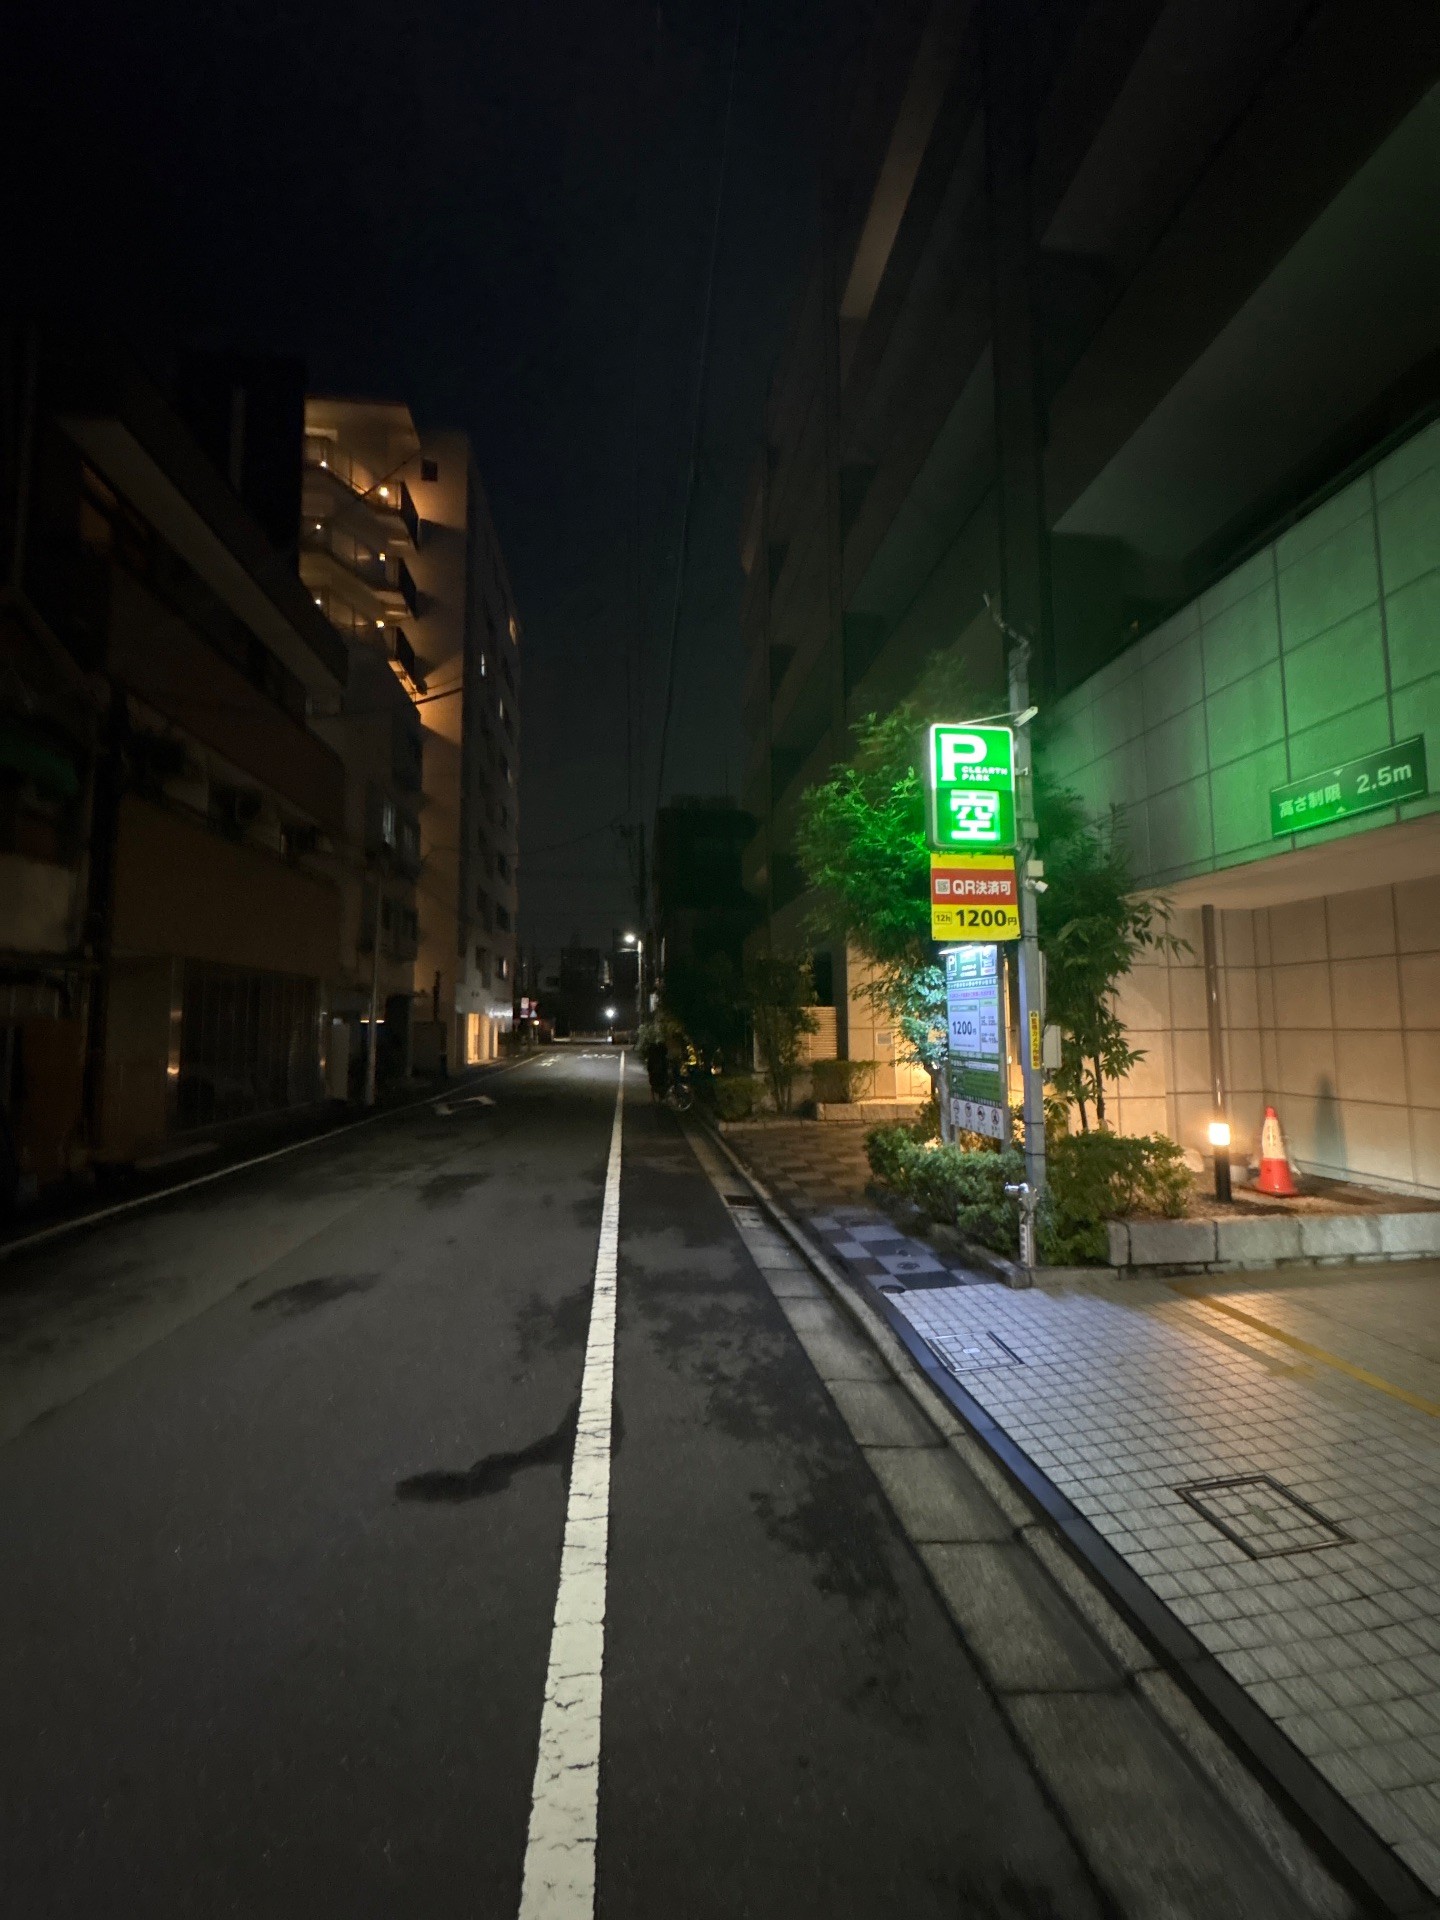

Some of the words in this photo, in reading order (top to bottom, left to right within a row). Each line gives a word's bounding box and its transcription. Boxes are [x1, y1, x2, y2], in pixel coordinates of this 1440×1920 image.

[940, 733, 987, 781] P
[961, 773, 990, 782] PARK
[1278, 783, 1342, 818] 高さ制限
[1356, 764, 1412, 794] 2.5m
[950, 790, 1000, 841] 空
[952, 879, 1012, 896] QR決済可
[955, 909, 1017, 927] 1200円
